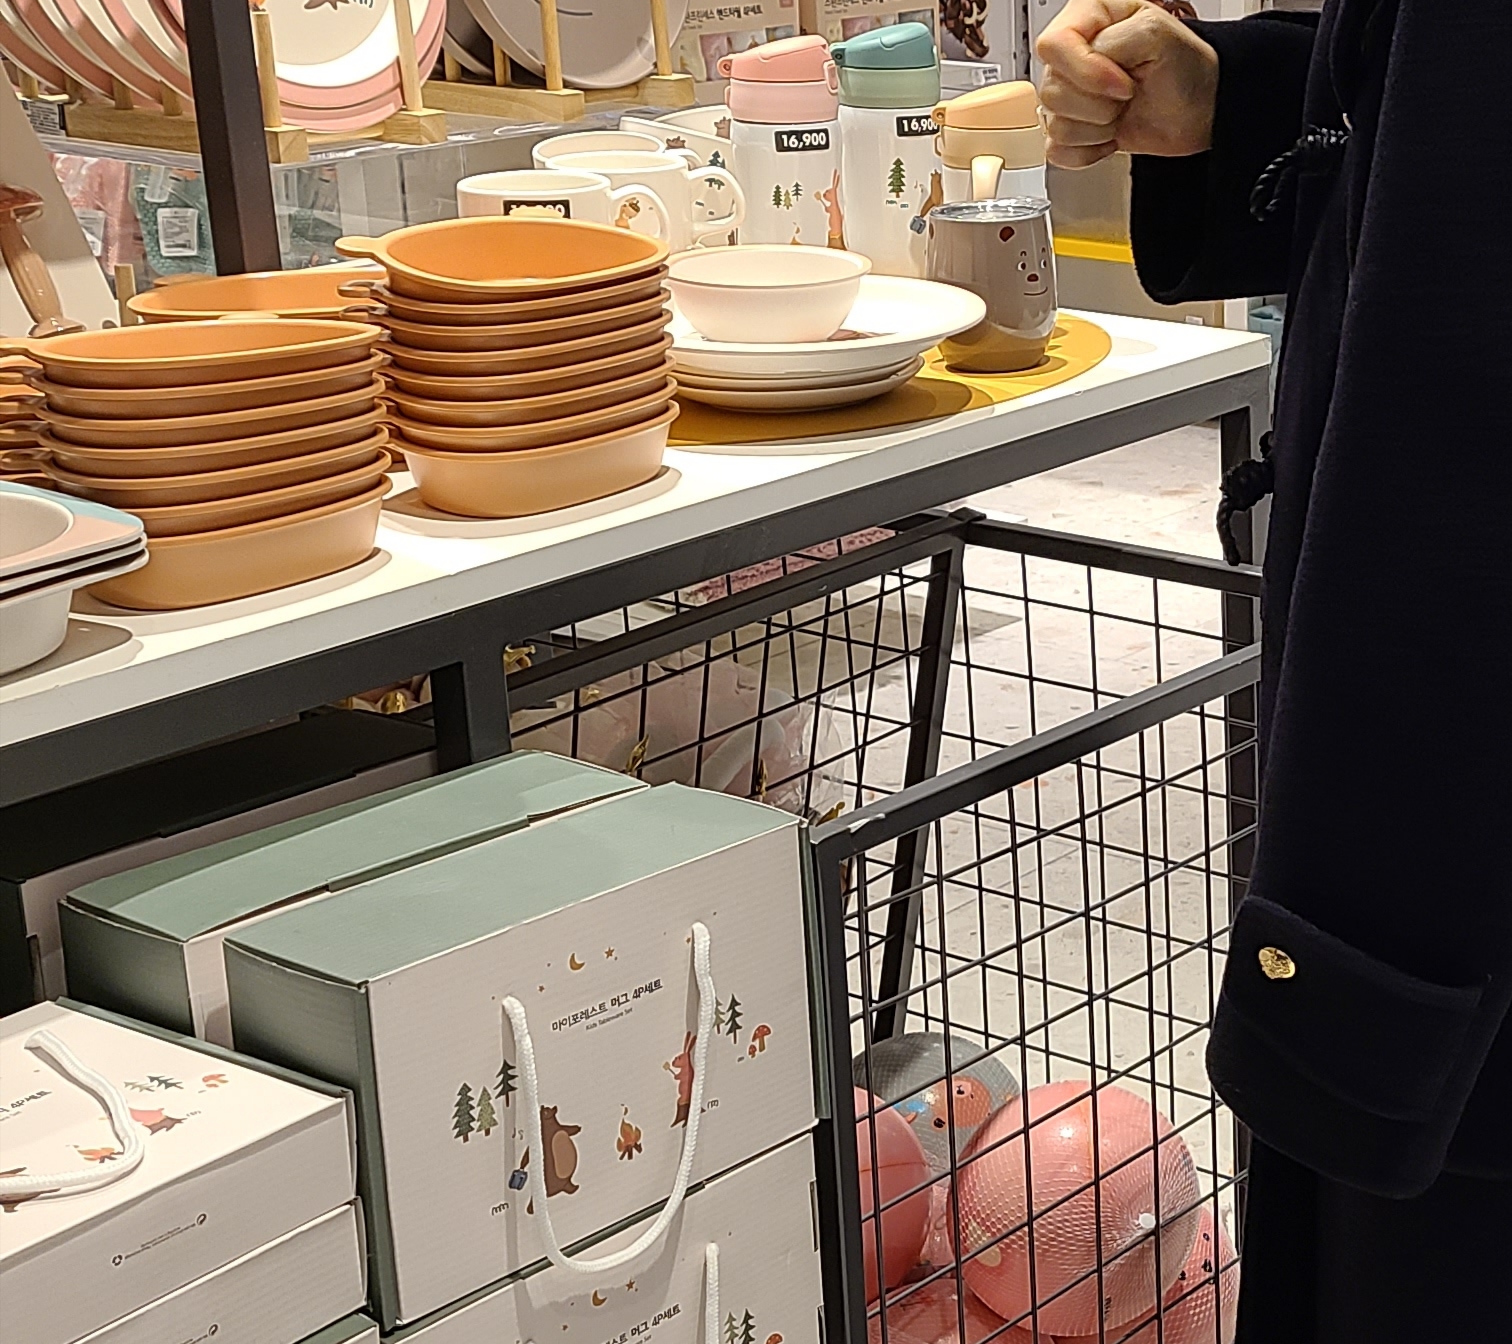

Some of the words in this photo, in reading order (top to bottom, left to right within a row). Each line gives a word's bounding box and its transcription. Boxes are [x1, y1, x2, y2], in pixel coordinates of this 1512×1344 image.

[781, 131, 827, 149] 16,900
[552, 1002, 608, 1031] 마이포레스트
[610, 992, 630, 1007] 머그
[632, 979, 663, 999] 4P세트
[630, 1320, 649, 1336] 머그
[651, 1304, 682, 1327] 4P세트
